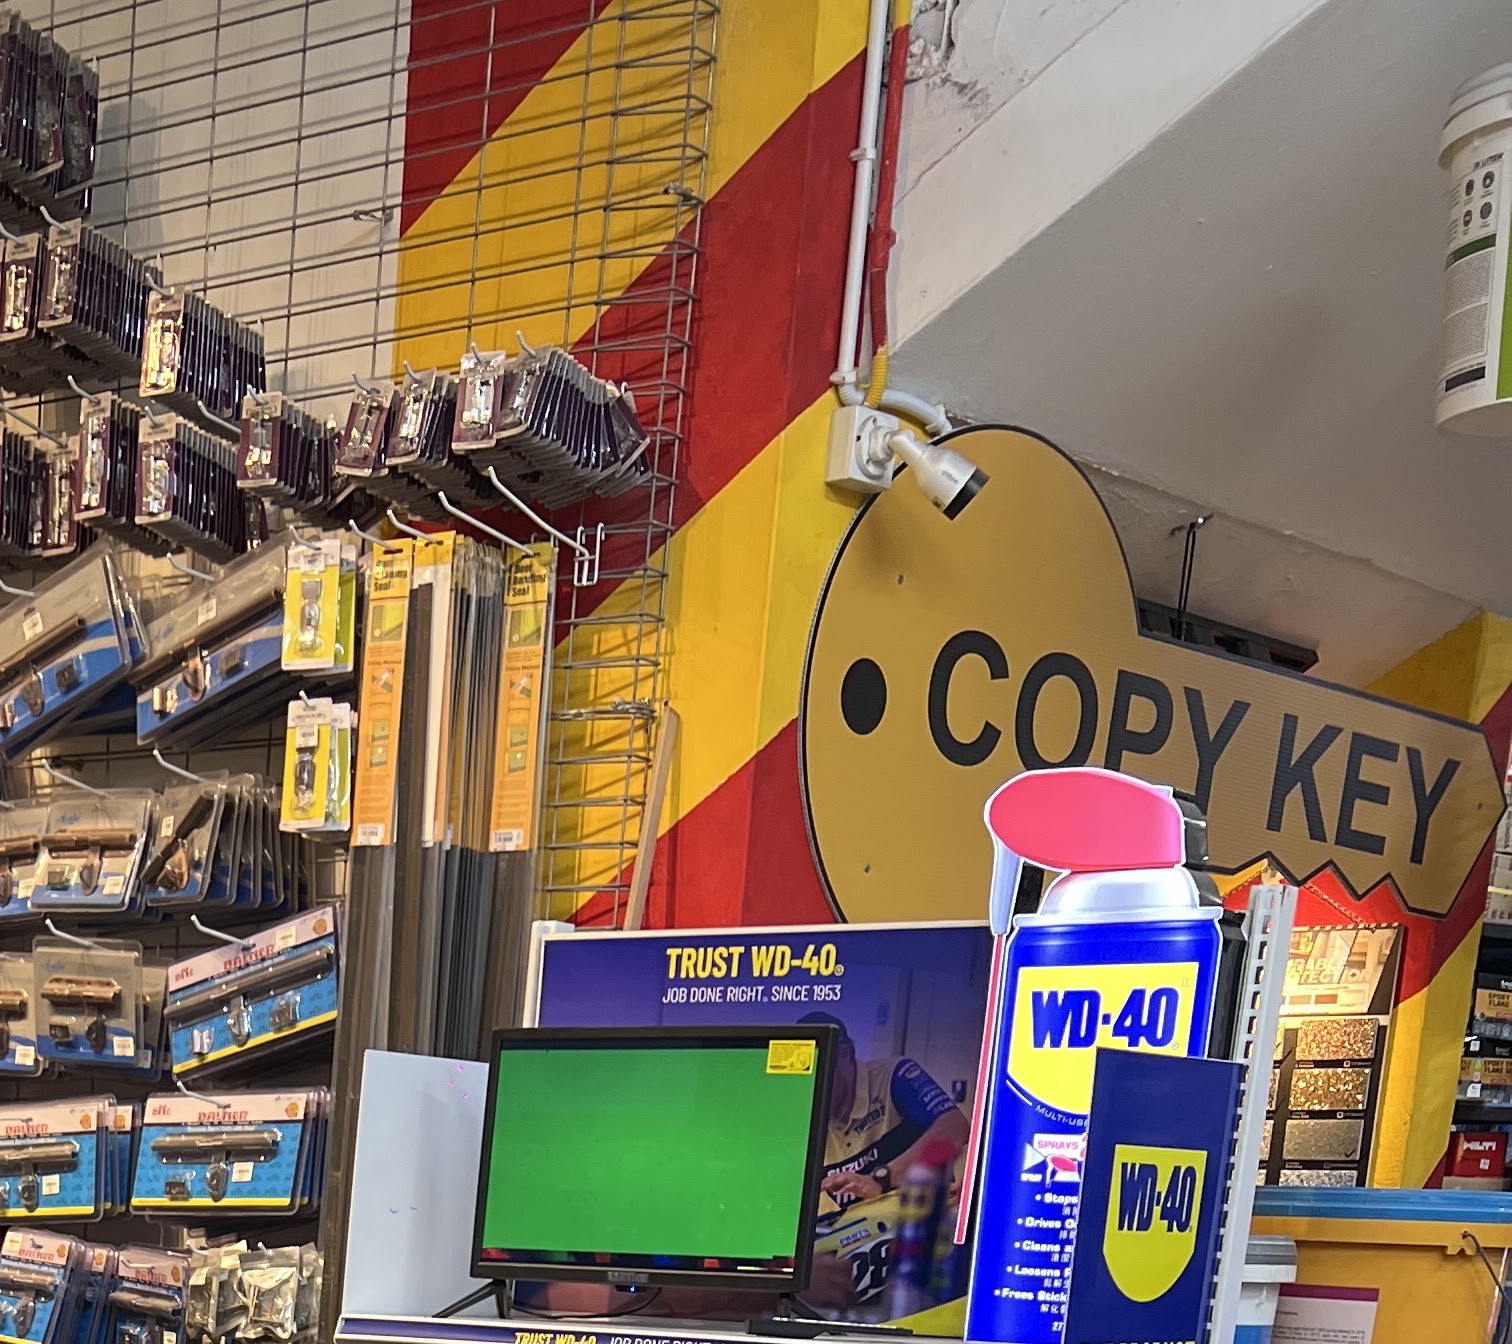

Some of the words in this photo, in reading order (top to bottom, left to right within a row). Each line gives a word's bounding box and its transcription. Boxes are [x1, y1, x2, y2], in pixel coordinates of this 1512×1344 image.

[374, 582, 391, 592] Seal
[512, 587, 530, 598] Seal
[927, 627, 1252, 807] COPY
[1265, 713, 1459, 866] KEY
[666, 946, 745, 979] TRUST
[662, 987, 687, 1004] JOB
[690, 986, 724, 1003] DONE
[771, 985, 810, 1001] SINCE
[813, 984, 842, 1001] 1953
[1031, 987, 1180, 1050] WD-40
[1037, 1140, 1079, 1150] SPRAYS
[1044, 1193, 1078, 1205] Stops
[1117, 1158, 1197, 1235] WD-40
[1026, 1217, 1062, 1228] Drives
[1022, 1241, 1061, 1252] Cleans
[1015, 1264, 1061, 1277] Loosens
[1002, 1287, 1034, 1300] Frees
